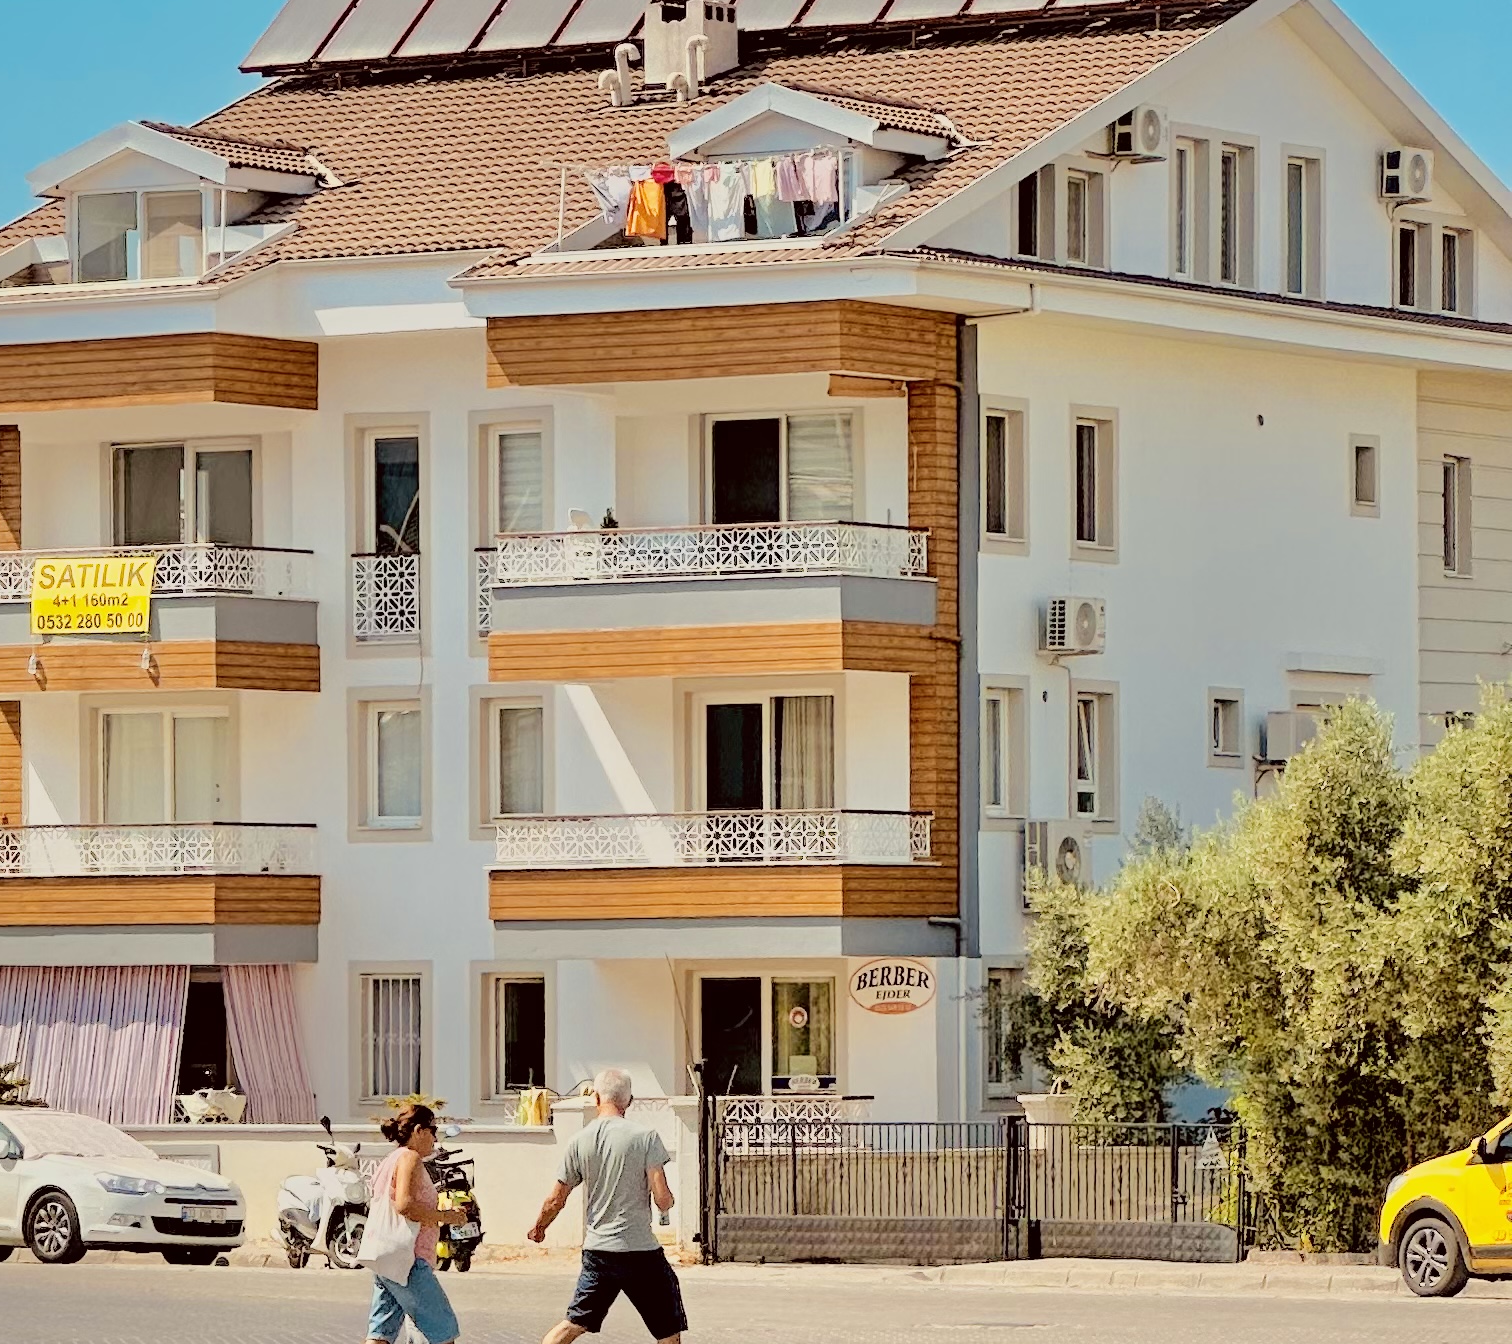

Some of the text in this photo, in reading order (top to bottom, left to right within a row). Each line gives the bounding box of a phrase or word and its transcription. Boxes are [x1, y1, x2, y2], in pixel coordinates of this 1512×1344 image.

[38, 562, 149, 590] SATILIK
[52, 593, 129, 607] 4+1 160m2
[37, 612, 143, 630] 0532 280 50 00
[856, 966, 930, 991] BERBER
